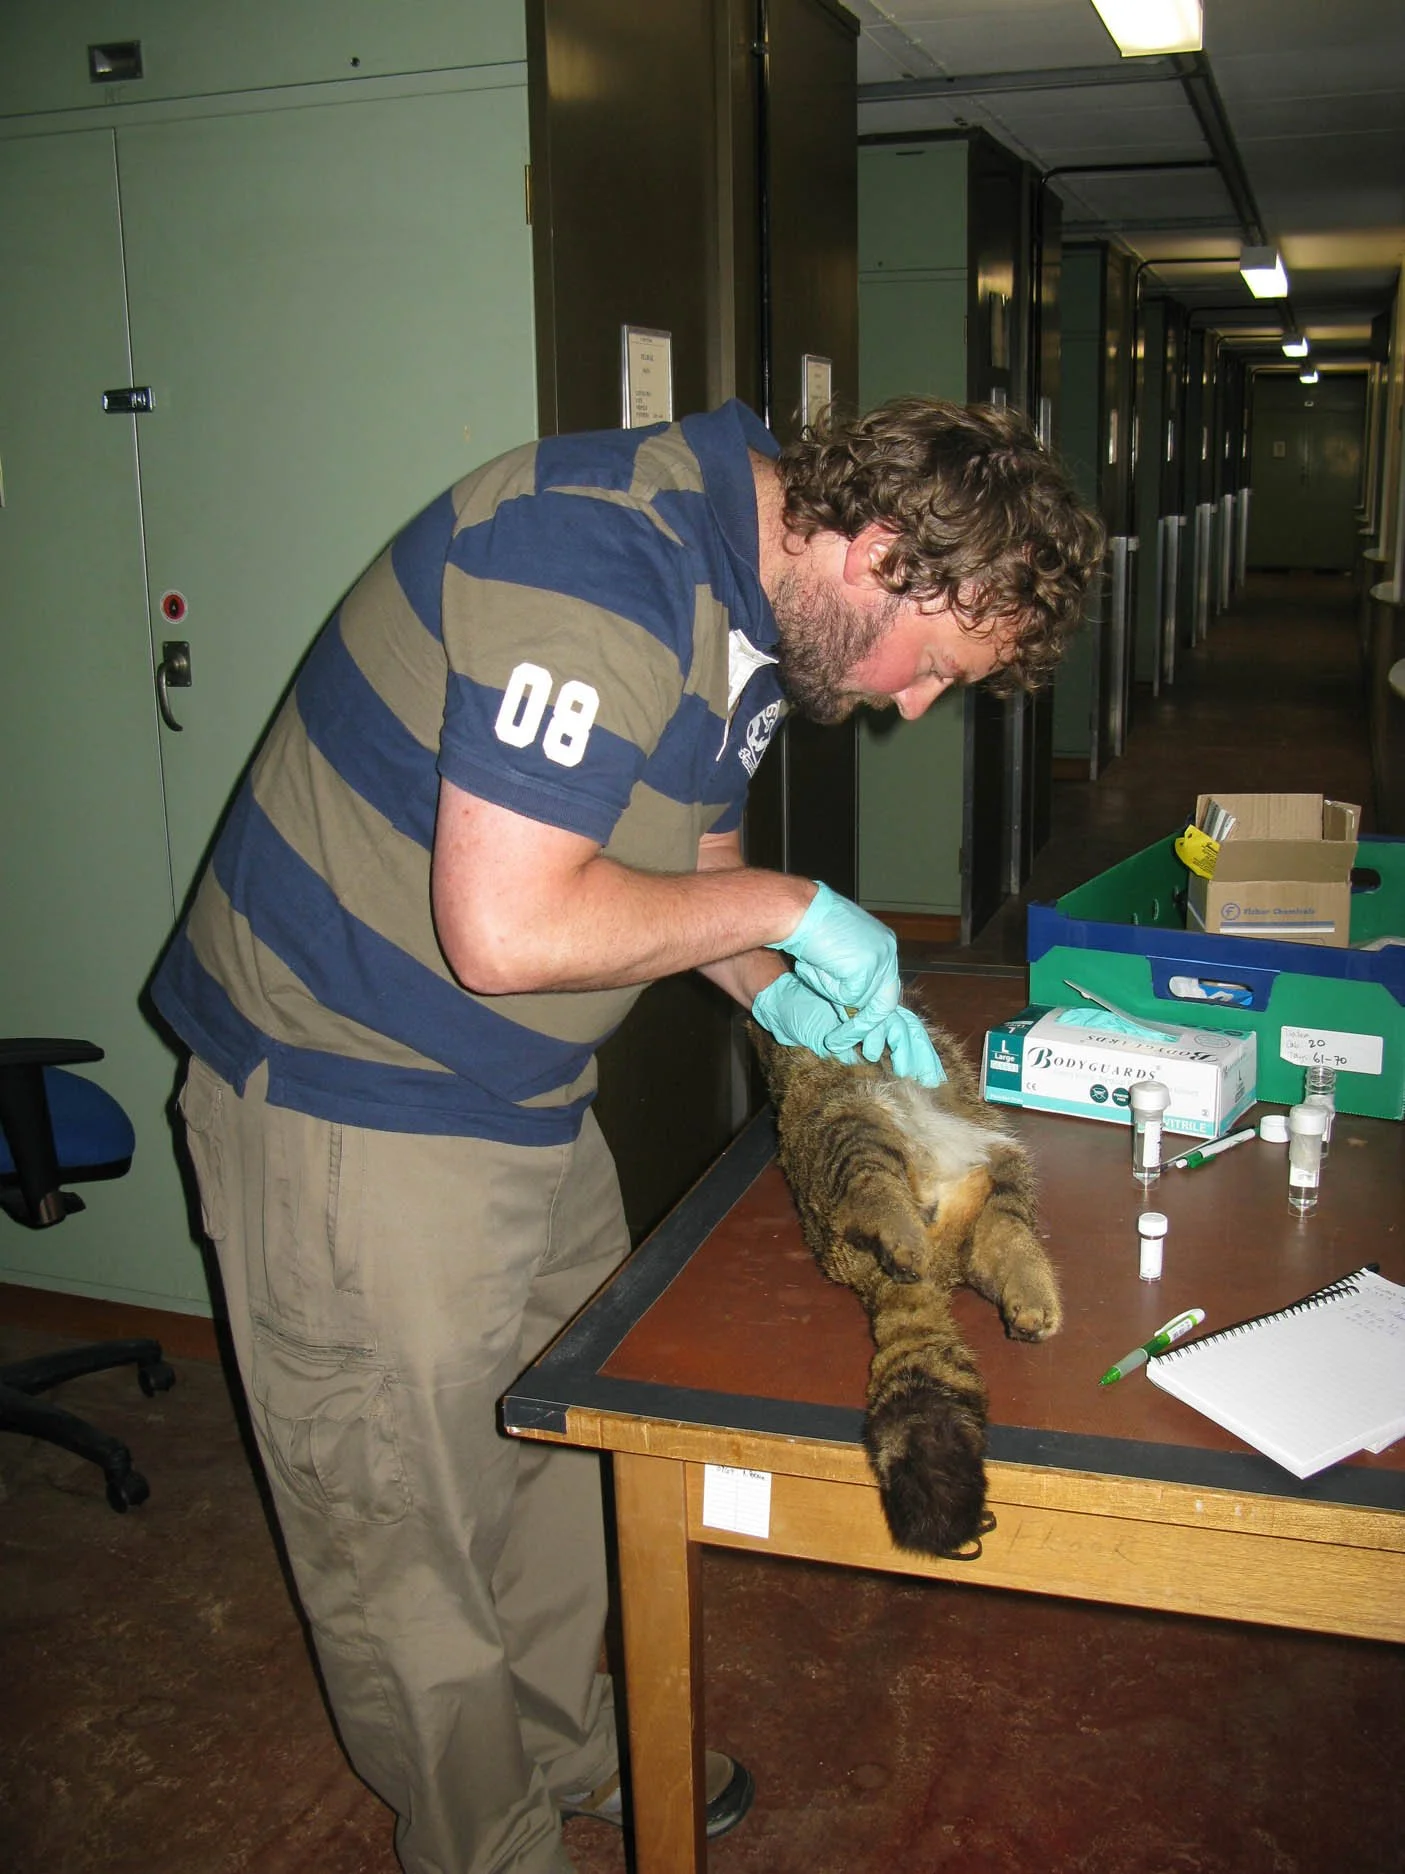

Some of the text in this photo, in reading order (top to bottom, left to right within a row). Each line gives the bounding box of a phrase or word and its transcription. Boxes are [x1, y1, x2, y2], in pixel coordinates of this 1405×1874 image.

[494, 662, 600, 768] 08
[1001, 1039, 1010, 1053] L
[1308, 1039, 1326, 1049] 20
[994, 1052, 1016, 1064] Large
[1027, 1046, 1156, 1081] BODYGUARDS
[1312, 1051, 1348, 1066] 61-70
